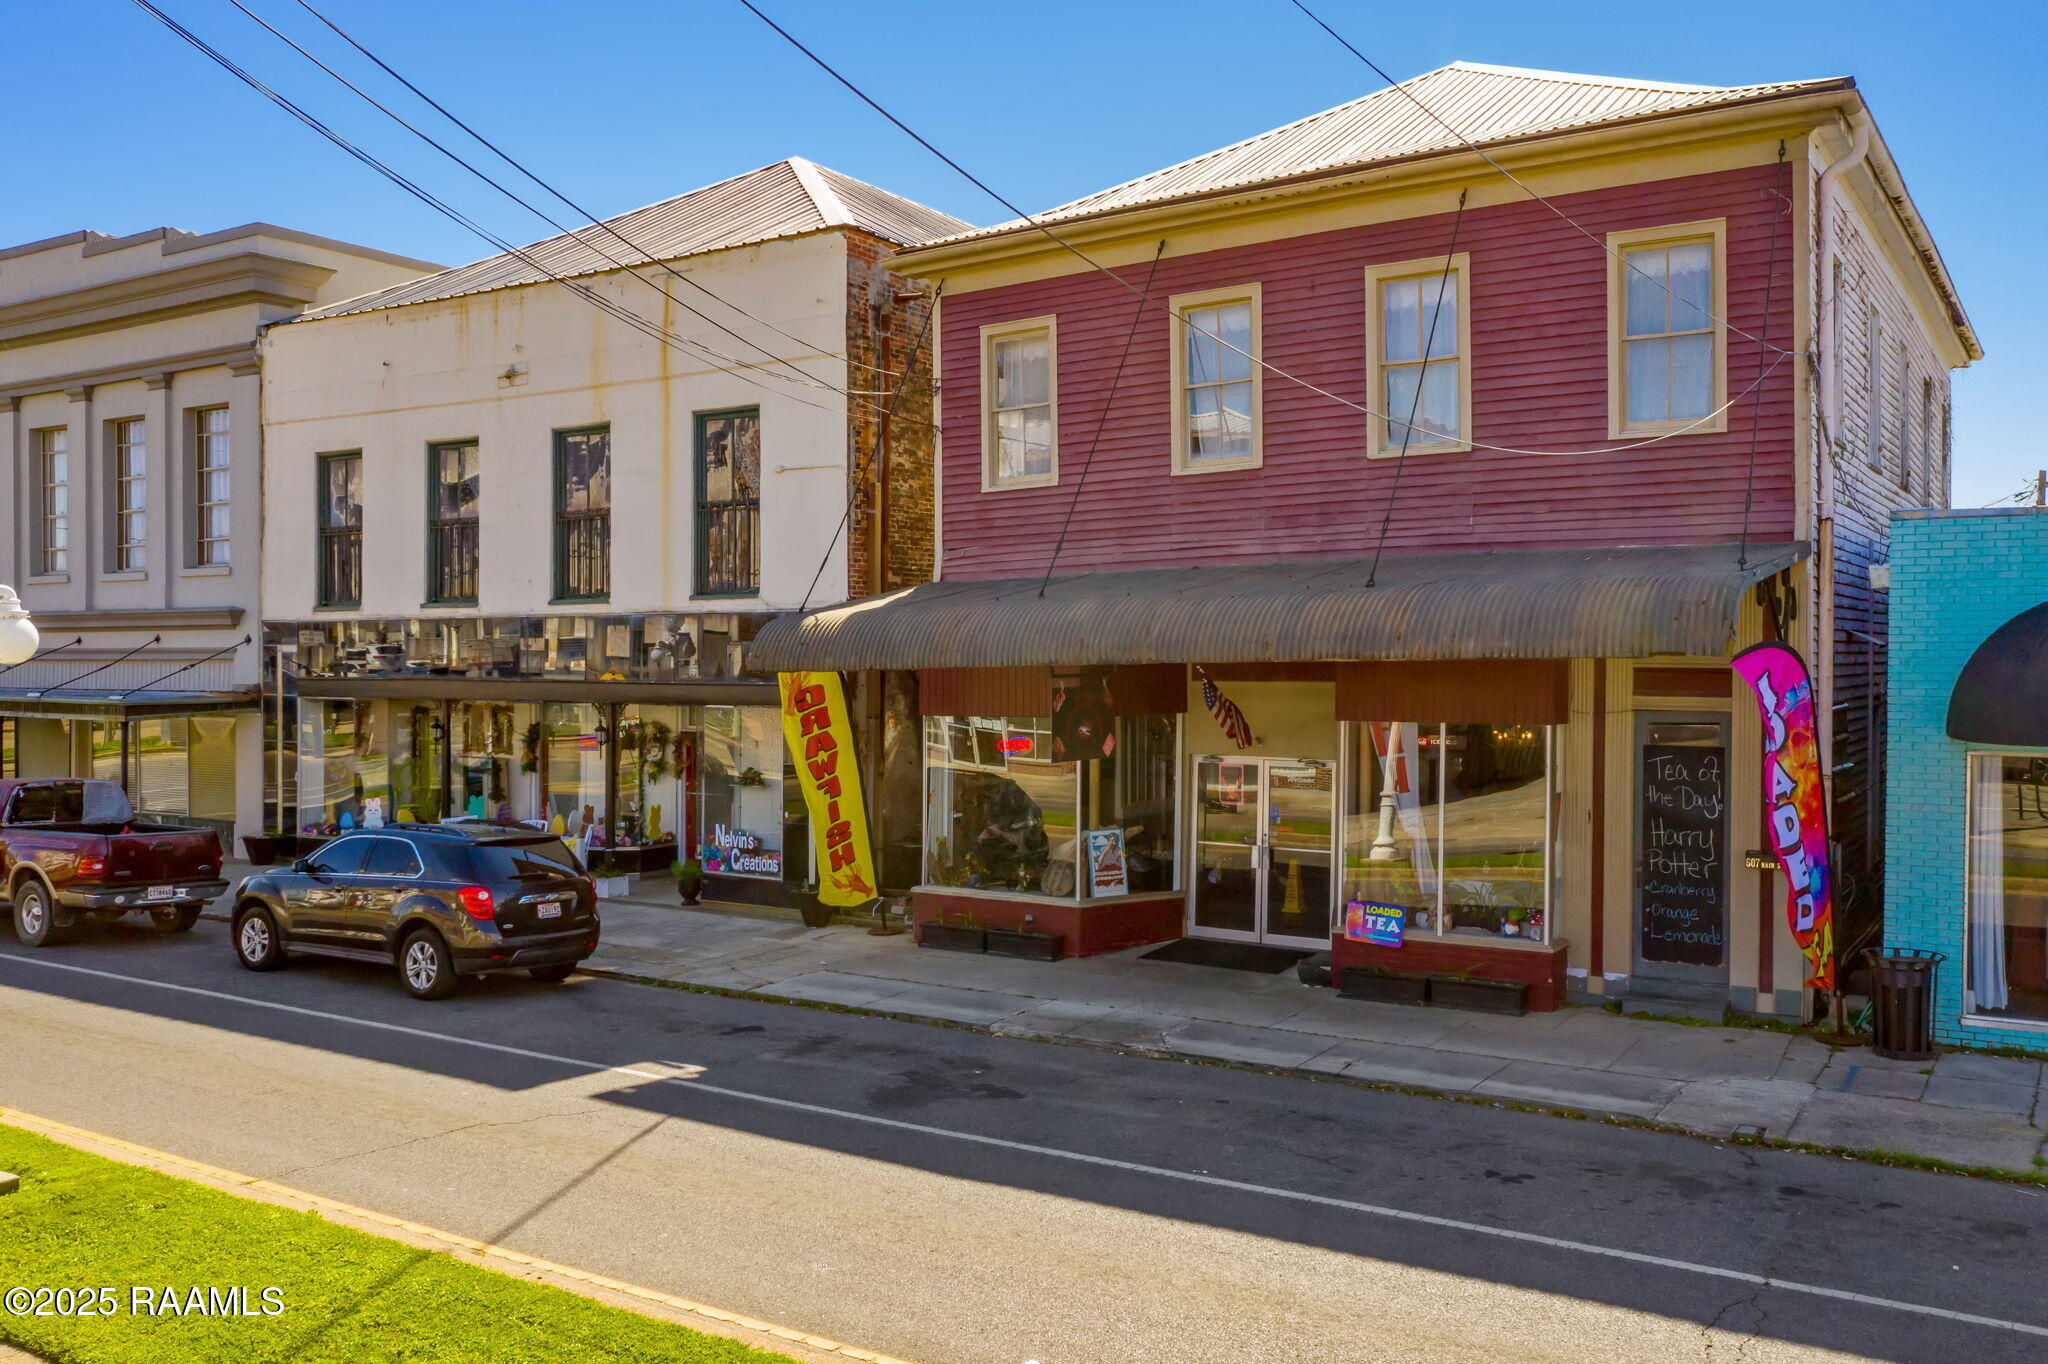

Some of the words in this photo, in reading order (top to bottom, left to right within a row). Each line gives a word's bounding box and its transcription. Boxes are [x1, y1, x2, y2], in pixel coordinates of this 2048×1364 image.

[1647, 755, 1690, 781] Tea
[1698, 756, 1720, 782] of
[1645, 785, 1674, 806] the
[1757, 671, 1815, 931] LOADED
[715, 824, 754, 849] Nelvin's
[1651, 817, 1714, 861] Harry
[731, 848, 779, 873] Creations
[1647, 849, 1718, 879] Potter
[1649, 880, 1716, 904] Cranberry
[1366, 905, 1403, 918] LOADED
[1652, 904, 1700, 927] Orange
[1365, 915, 1401, 934] TEA
[1651, 922, 1723, 946] Lemonade
